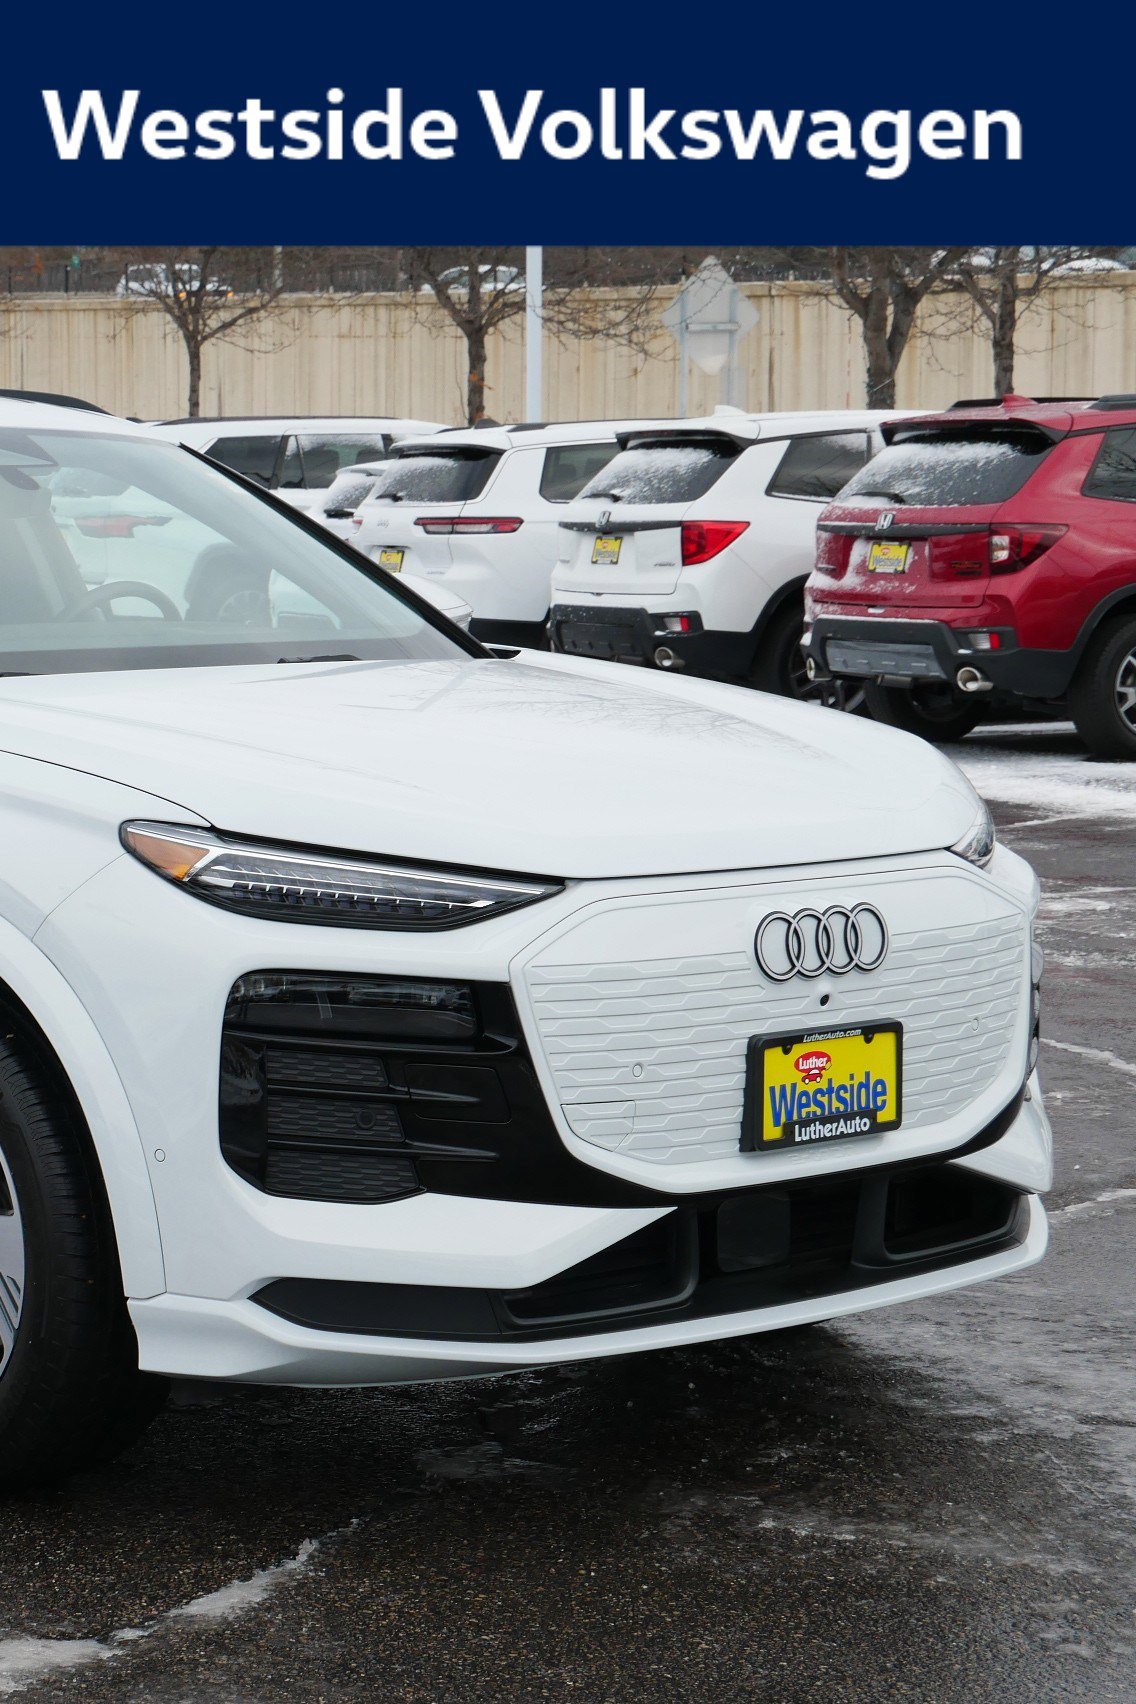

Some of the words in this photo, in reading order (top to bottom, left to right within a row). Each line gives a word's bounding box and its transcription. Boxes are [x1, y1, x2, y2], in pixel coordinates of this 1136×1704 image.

[803, 1029, 862, 1043] LutherAuto.com
[798, 1055, 829, 1071] Luther
[768, 1070, 888, 1128] Westside
[794, 1116, 871, 1142] LutherAuto
